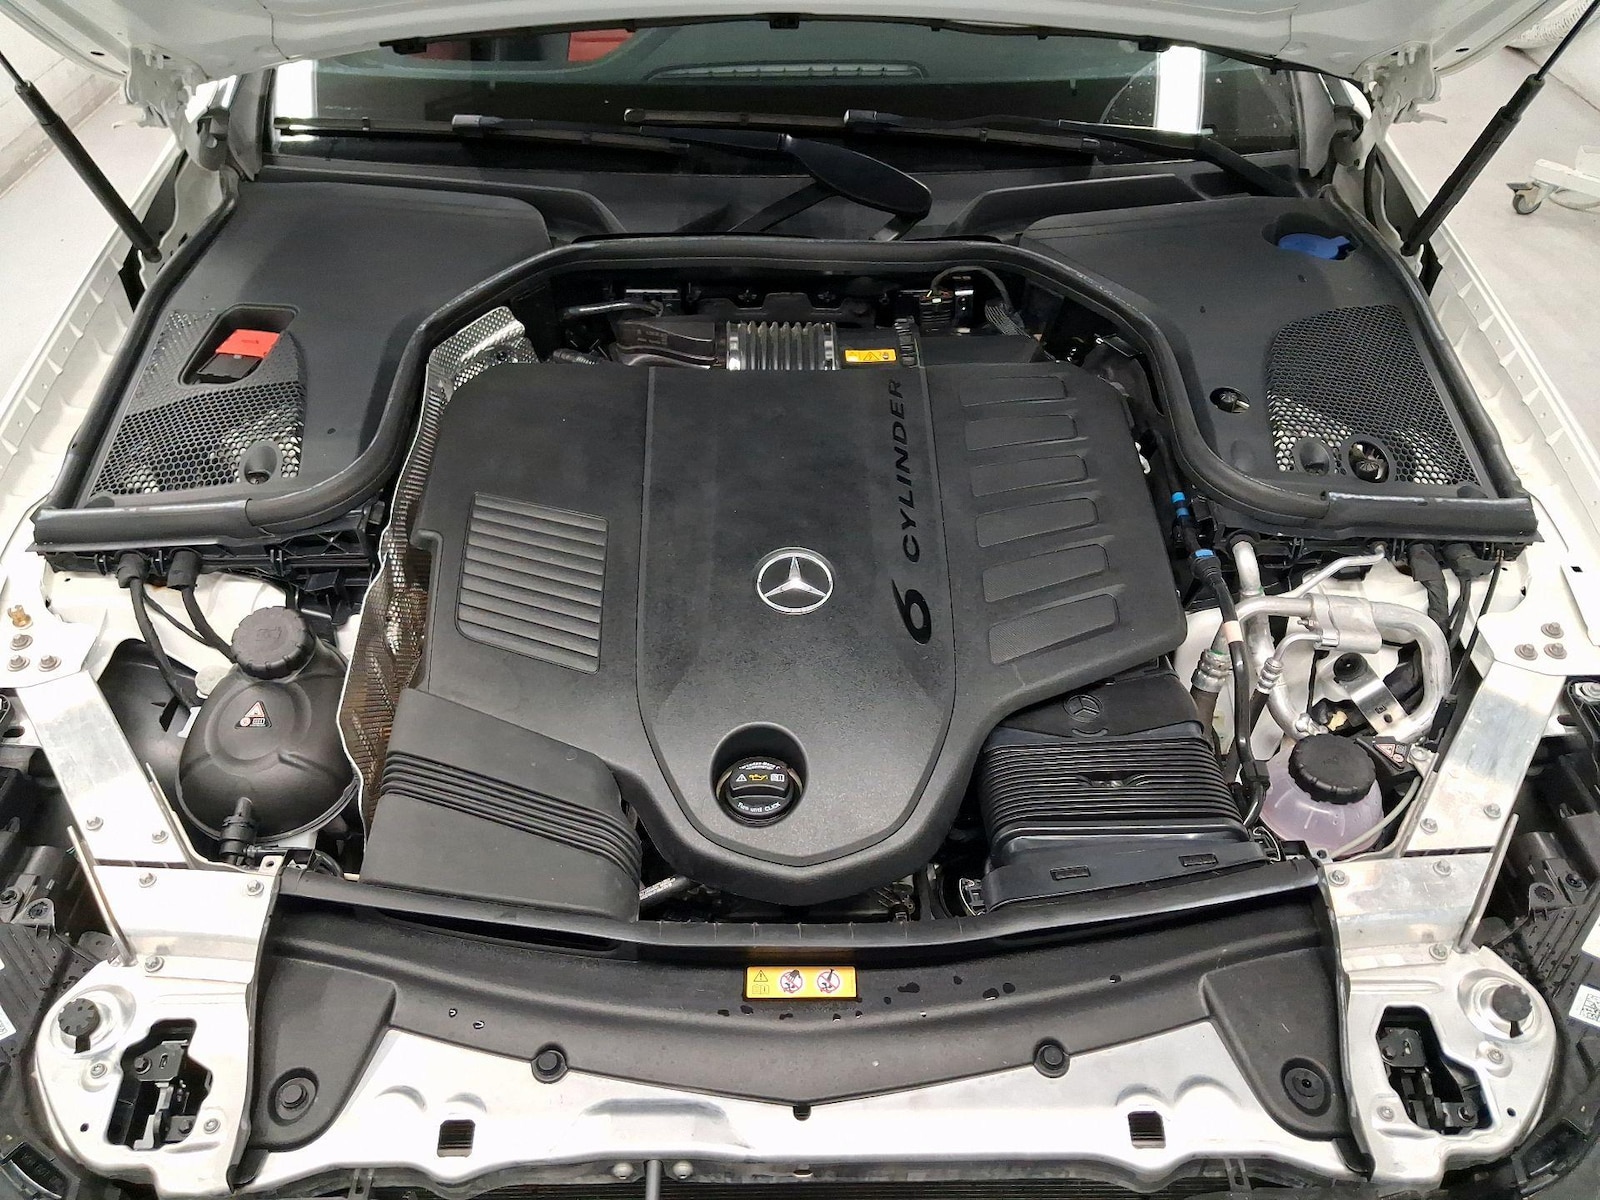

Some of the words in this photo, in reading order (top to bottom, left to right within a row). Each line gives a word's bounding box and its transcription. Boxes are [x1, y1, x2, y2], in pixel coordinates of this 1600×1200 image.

[888, 378, 921, 563] CYLINDER
[891, 578, 932, 645] 6
[737, 801, 750, 811] Turn
[764, 801, 781, 812] CLICK
